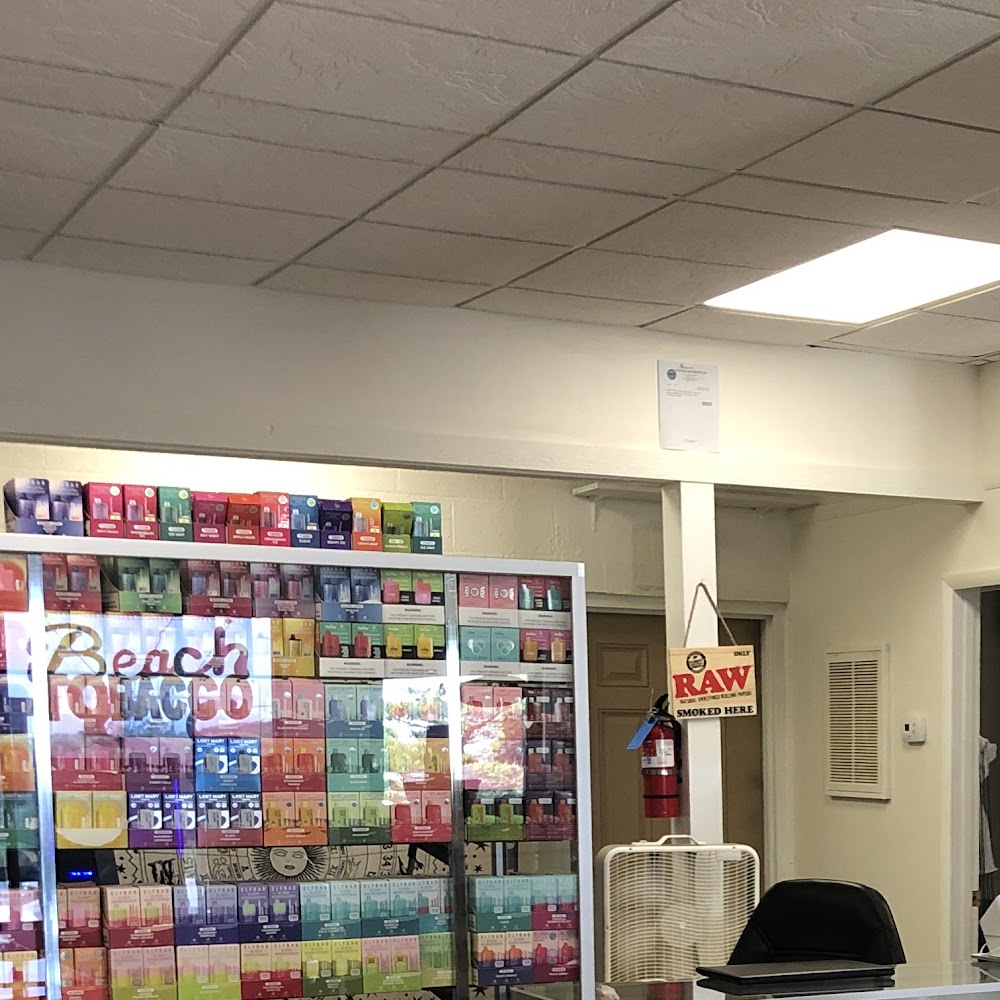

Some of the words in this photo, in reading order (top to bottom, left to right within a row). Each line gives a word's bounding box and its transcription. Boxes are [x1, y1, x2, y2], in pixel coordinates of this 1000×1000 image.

[45, 623, 249, 678] Beach
[672, 664, 754, 699] RAW
[676, 707, 722, 718] SMOKED
[724, 705, 754, 715] HERE
